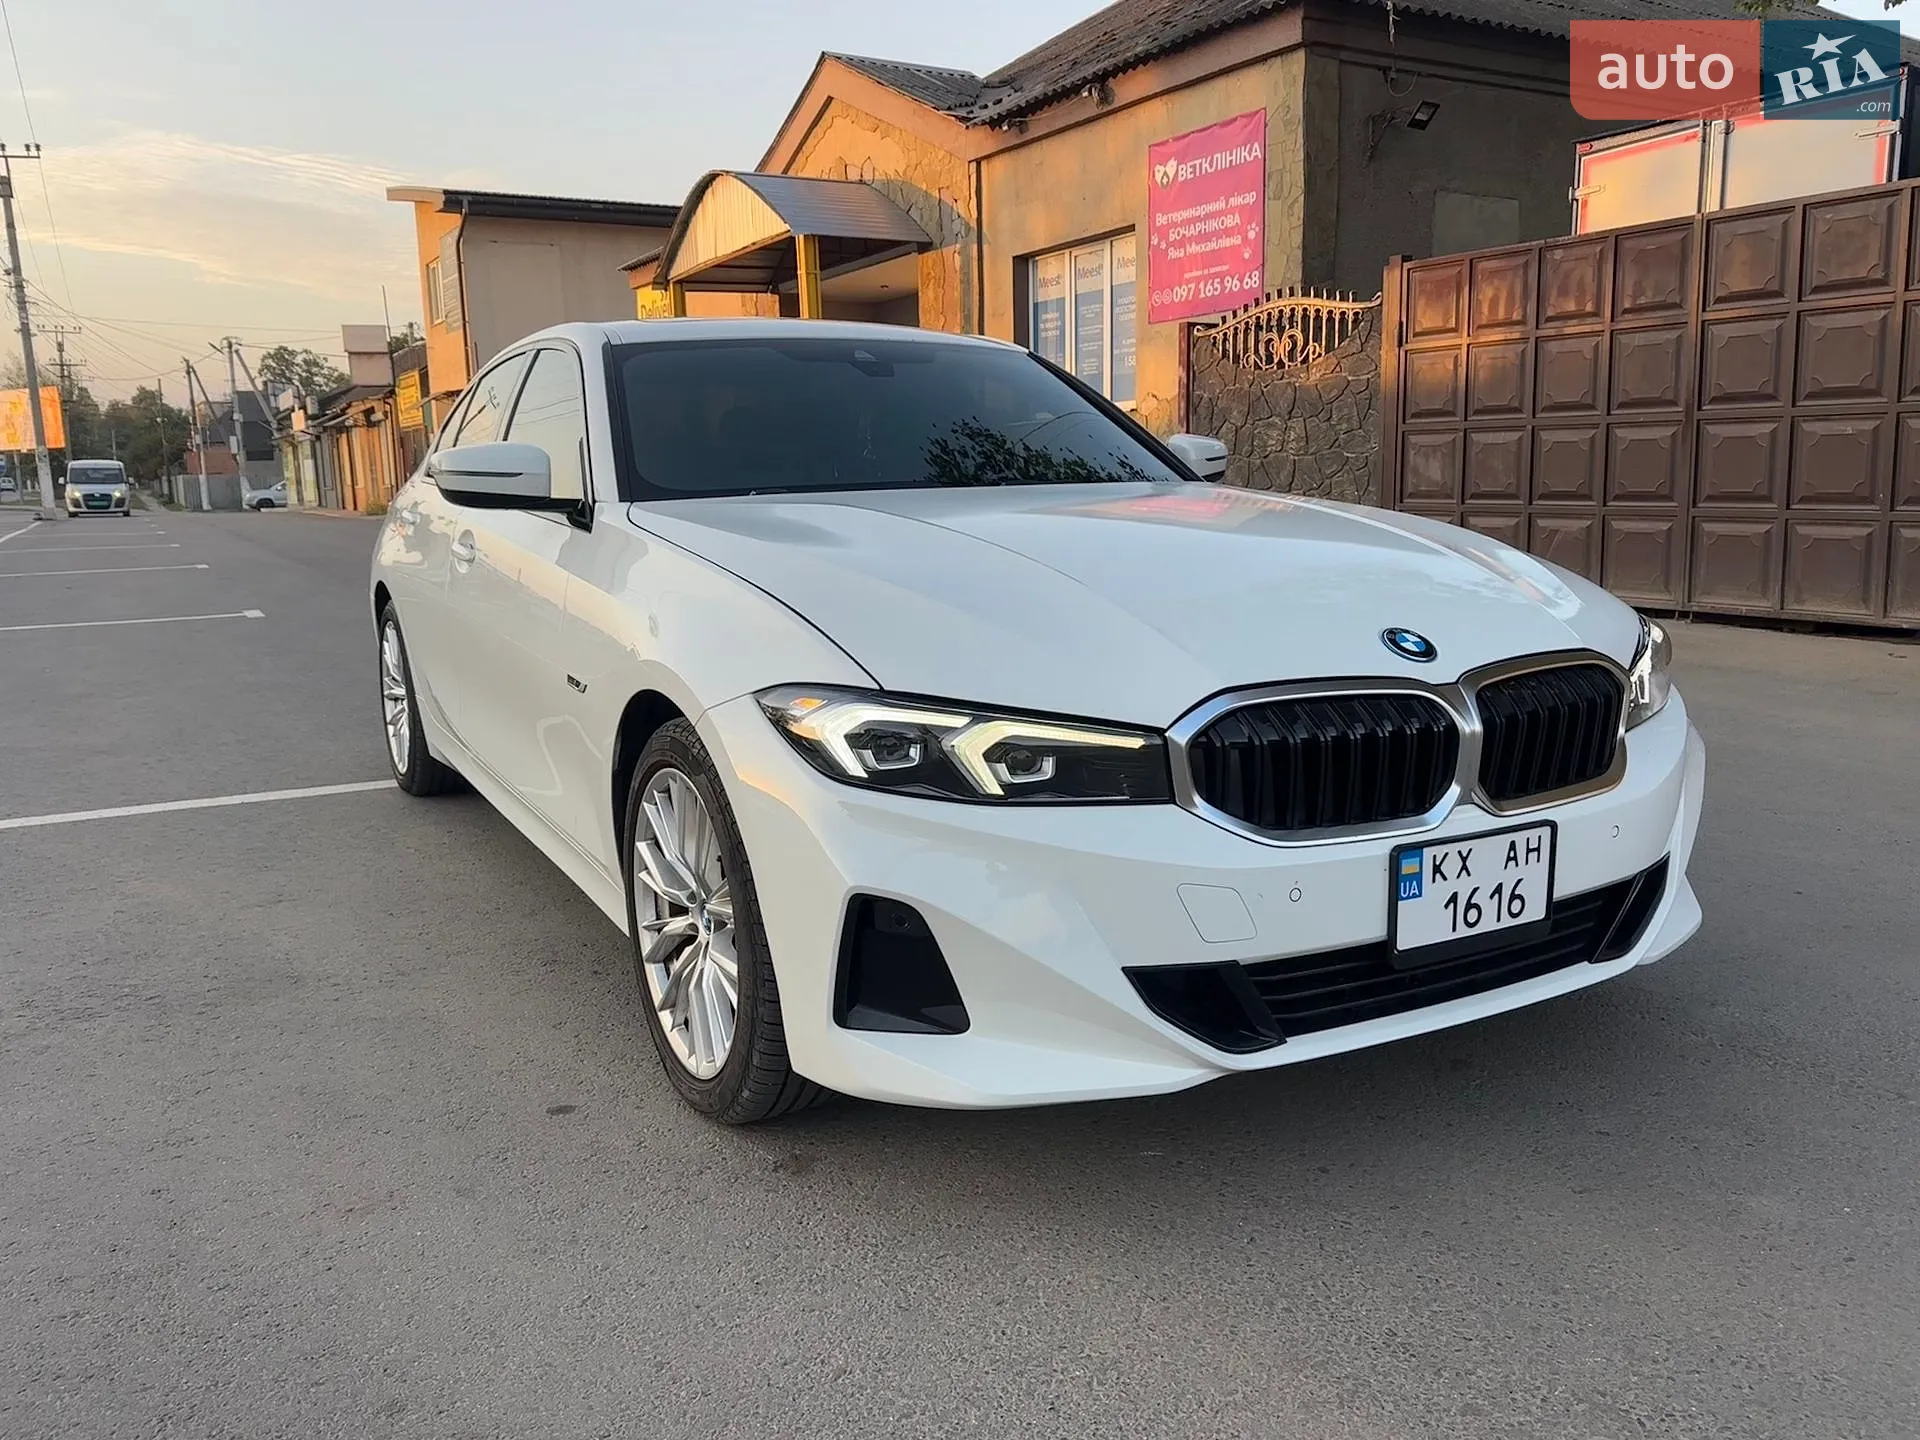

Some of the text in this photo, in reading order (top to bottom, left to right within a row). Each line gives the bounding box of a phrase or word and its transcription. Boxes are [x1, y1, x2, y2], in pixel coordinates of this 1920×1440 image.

[1177, 141, 1262, 182] ВЕТКЛІНІКА
[1155, 191, 1257, 227] Ветеринарний лікар
[1168, 212, 1241, 242] БОЧАРНІКОВА
[1168, 234, 1242, 260] Яна Михайлівна
[1173, 282, 1196, 303] 097
[1198, 278, 1221, 299] 165
[1224, 273, 1241, 294] 96
[1243, 270, 1260, 290] 68
[1400, 880, 1420, 898] UA
[1443, 877, 1526, 933] 1616
